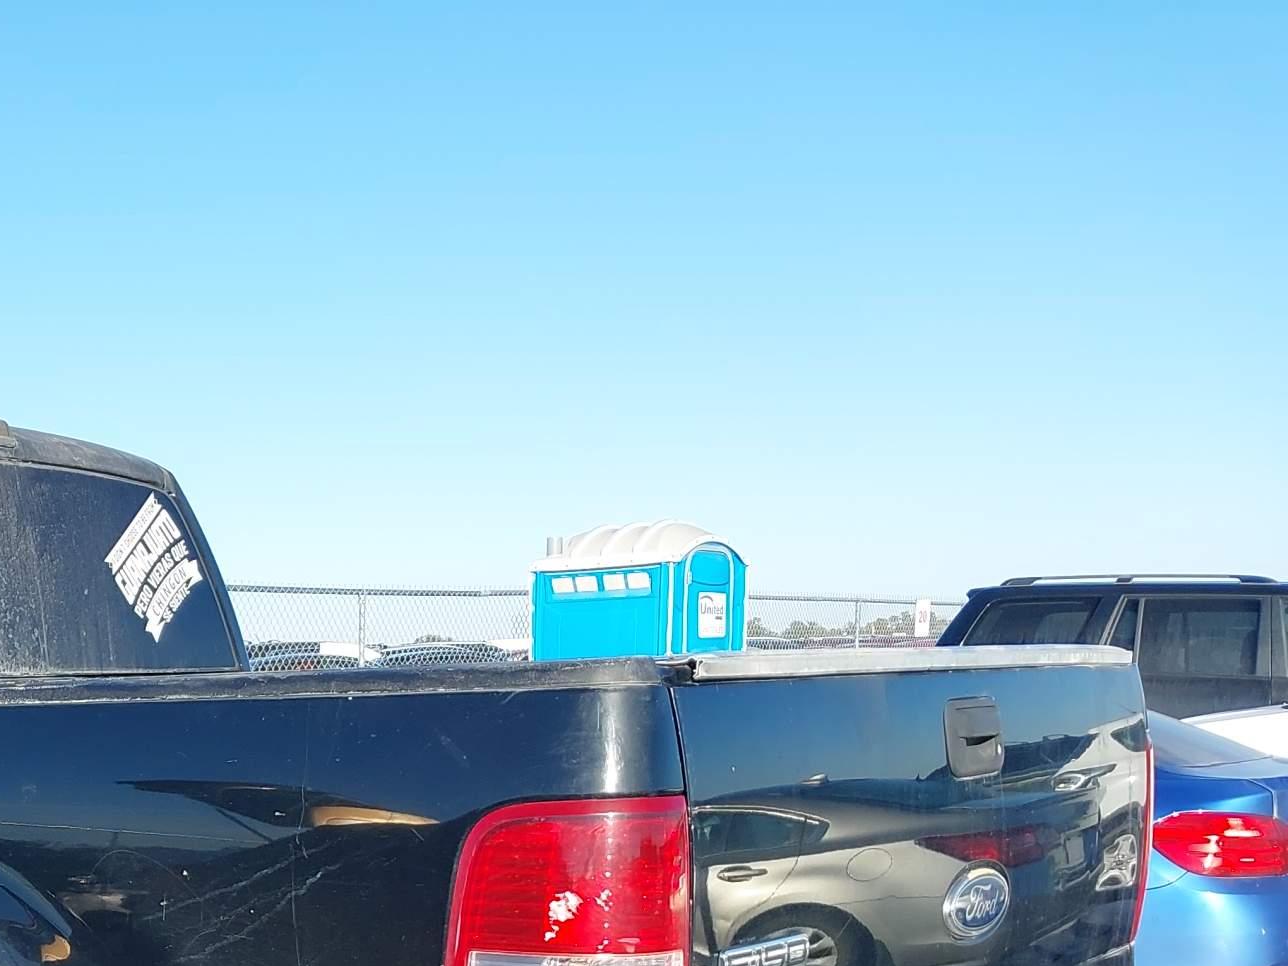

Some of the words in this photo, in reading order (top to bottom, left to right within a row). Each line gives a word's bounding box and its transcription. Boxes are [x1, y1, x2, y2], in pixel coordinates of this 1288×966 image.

[114, 508, 182, 605] GUANAJUATO
[133, 583, 154, 619] PERO
[147, 552, 174, 589] VIERAS
[171, 539, 189, 562] QUE
[152, 566, 187, 616] CHINGON
[162, 607, 175, 623] SE
[169, 585, 191, 613] SIENTE
[700, 602, 724, 615] United
[965, 883, 1000, 922] Ford
